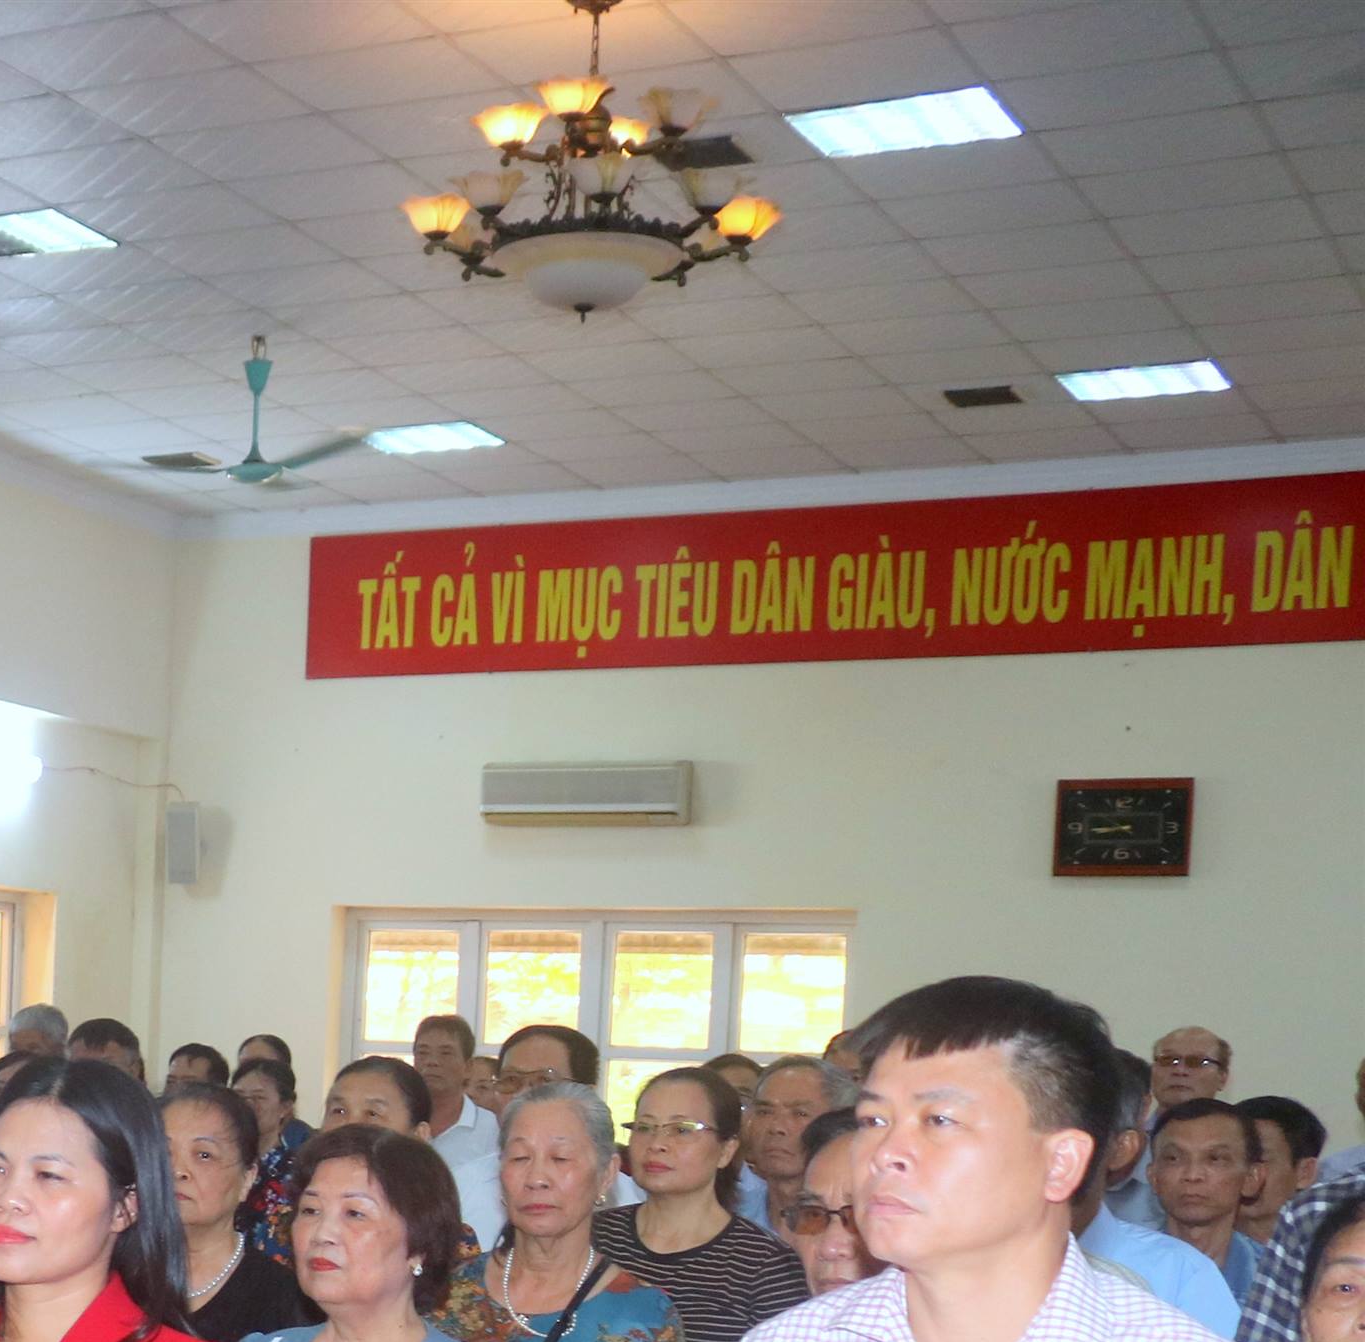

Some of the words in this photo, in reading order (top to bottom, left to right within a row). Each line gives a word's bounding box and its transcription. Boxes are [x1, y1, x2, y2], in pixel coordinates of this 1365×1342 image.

[357, 549, 422, 650] TẤT
[429, 541, 478, 647] CẢ
[490, 553, 526, 645] VÌ
[535, 565, 623, 658] MỤC
[634, 546, 720, 639] TIÊU
[729, 541, 817, 635] DÂN
[826, 534, 936, 639] GIÀU,
[949, 520, 1072, 626] NƯỚC
[1083, 532, 1235, 638] MẠNH,
[1249, 509, 1355, 613] DÂN
